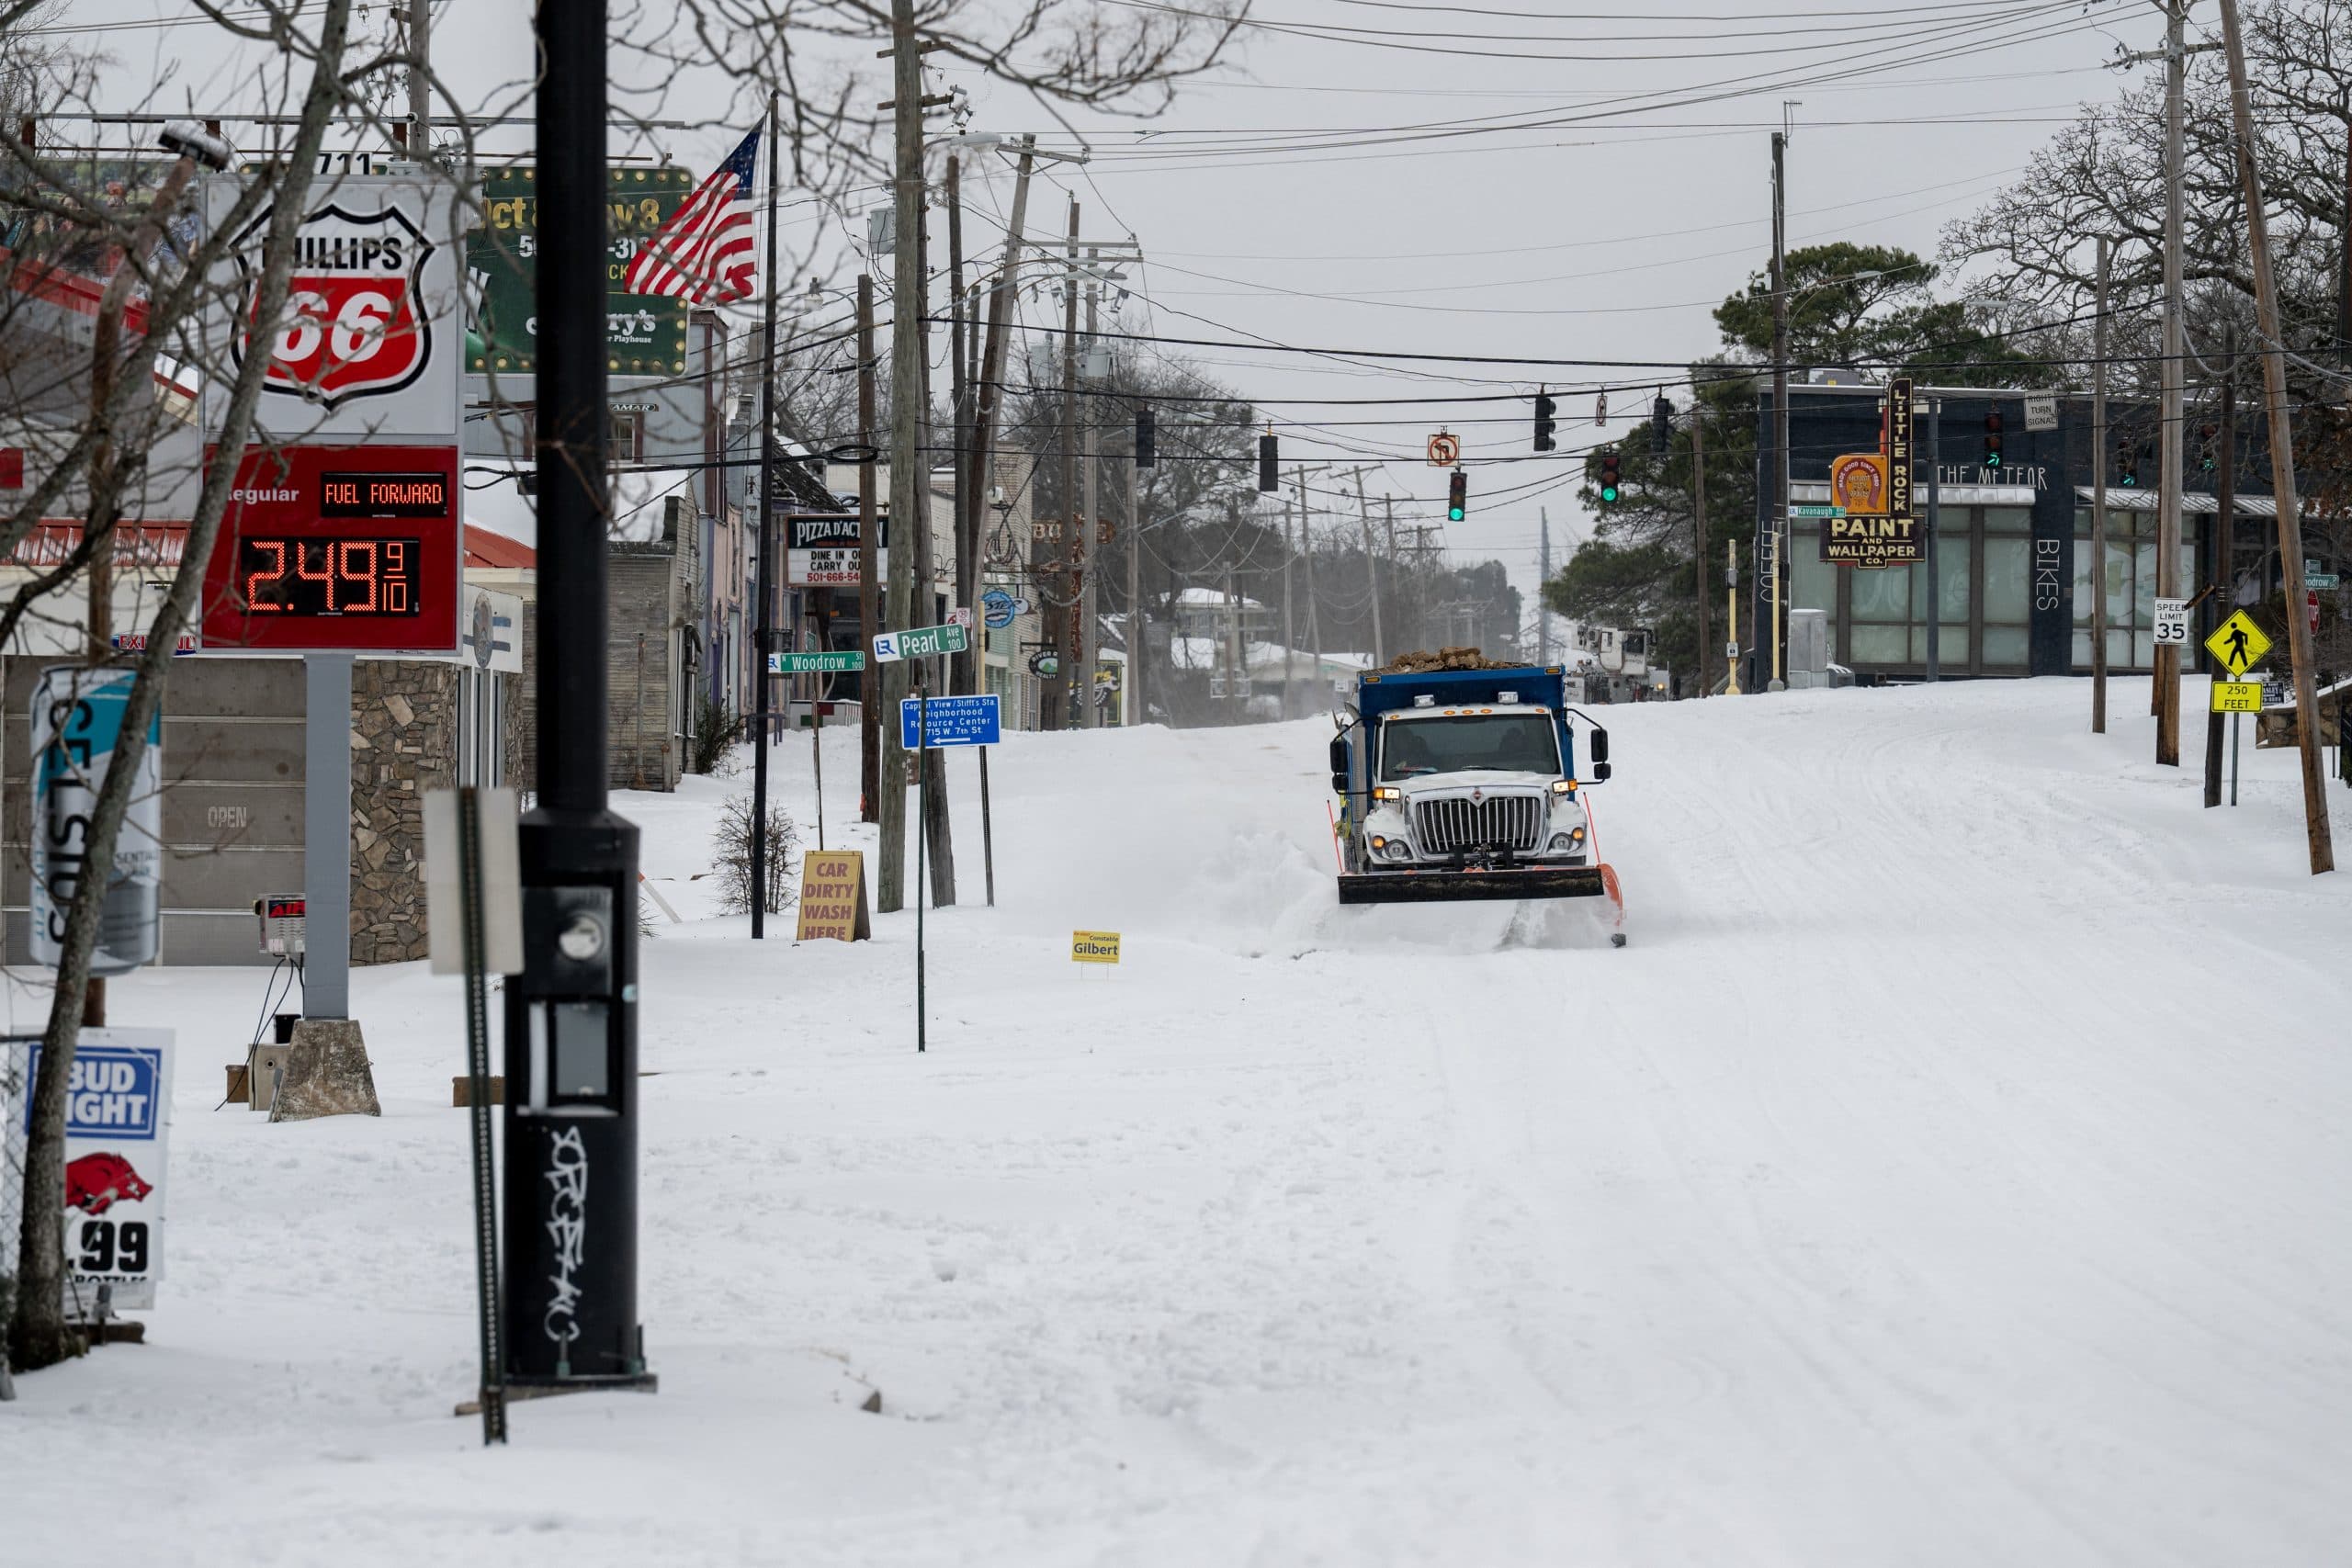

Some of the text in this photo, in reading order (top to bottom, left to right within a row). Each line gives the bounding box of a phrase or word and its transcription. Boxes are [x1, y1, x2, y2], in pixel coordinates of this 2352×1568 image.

[272, 291, 392, 363] 66
[614, 335, 651, 344] Playhouse
[2031, 405, 2052, 413] TURN
[2028, 417, 2056, 425] SIGNAL
[325, 484, 443, 504] FUEL FORWARD
[1894, 466, 1907, 511] ROCK
[227, 488, 300, 506] egular
[1799, 507, 1833, 517] Kavanaugh
[1831, 518, 1915, 536] PAINT
[796, 522, 831, 547] PIZZA
[810, 551, 831, 560] DINE
[835, 551, 844, 560] IN
[1828, 545, 1916, 557] WALLPAPER
[810, 561, 861, 571] CARRY OU
[248, 541, 377, 612] 2.49
[2036, 539, 2060, 611] BIKES
[2157, 623, 2185, 640] 35
[119, 634, 147, 650] EXI
[902, 630, 941, 656] Pearl
[946, 627, 959, 637] Ave
[948, 638, 961, 650] 100
[792, 655, 845, 671] Woodrow
[855, 652, 862, 660] St
[852, 660, 863, 669] 100
[2227, 685, 2248, 695] 250
[2224, 700, 2249, 709] FEET
[959, 717, 990, 726] Center
[208, 807, 247, 828] OPEN
[816, 863, 848, 877] CAR
[804, 884, 854, 898] DIRTY
[804, 905, 853, 919] WASH
[805, 926, 846, 941] HERE
[1074, 942, 1117, 955] Gilbert
[66, 1093, 147, 1125] IGHT
